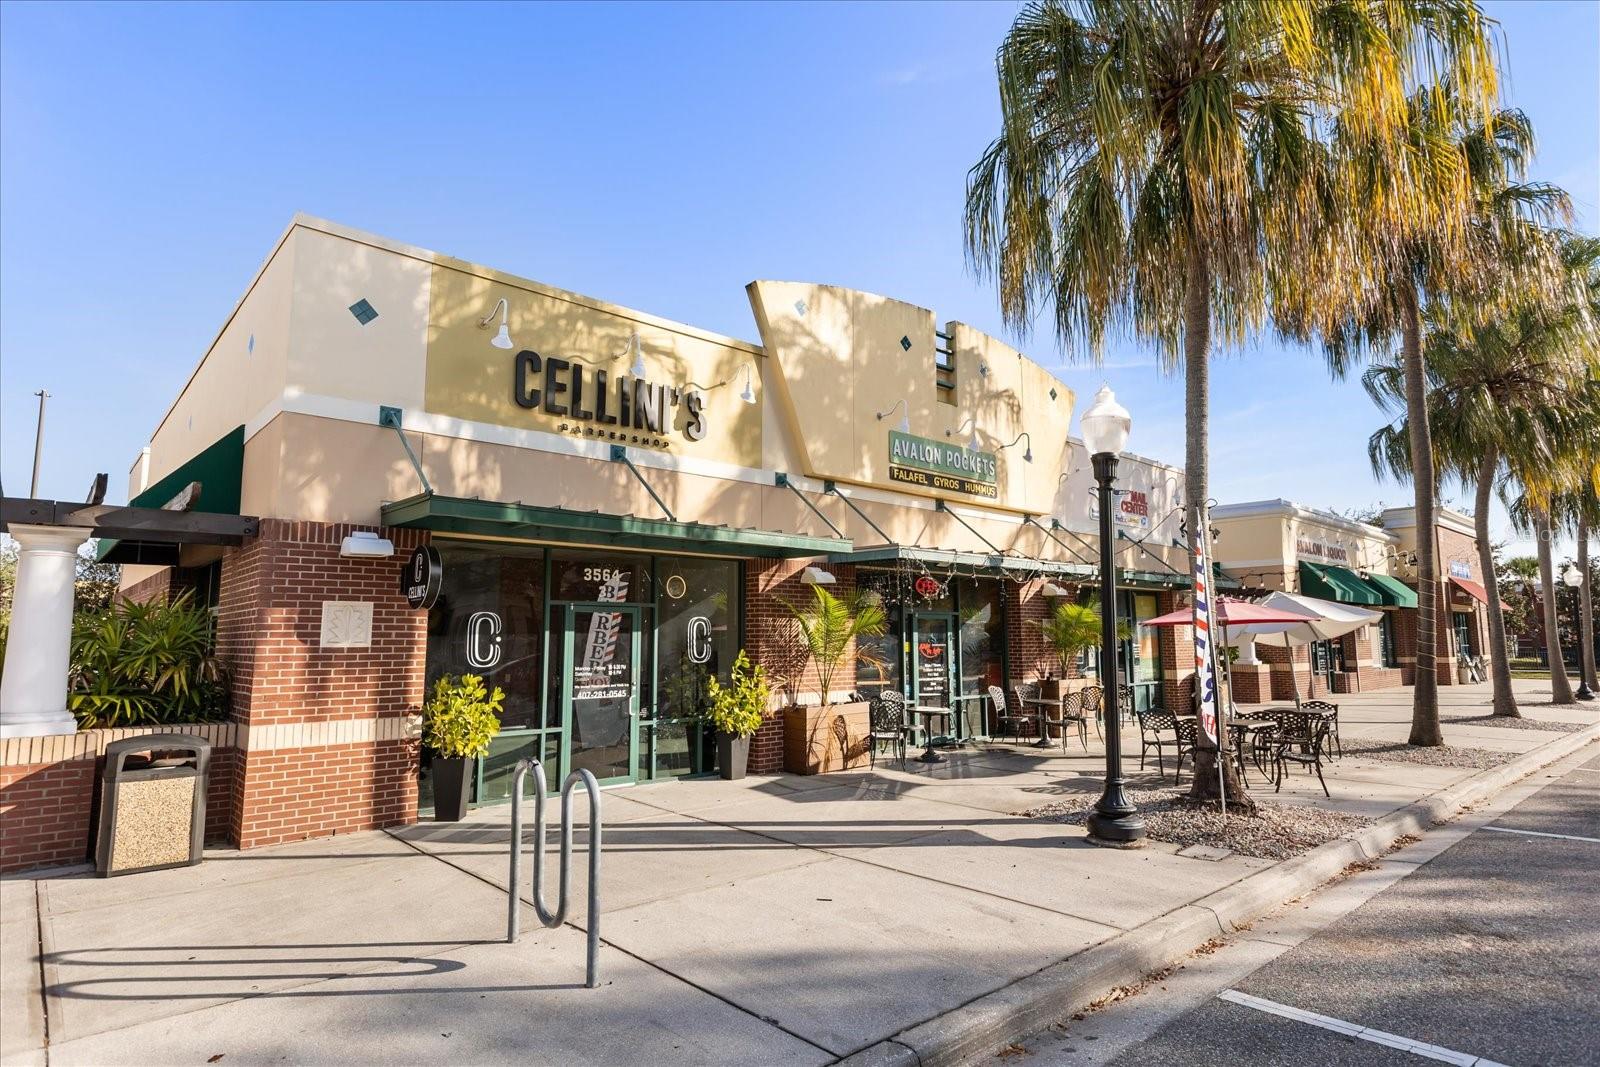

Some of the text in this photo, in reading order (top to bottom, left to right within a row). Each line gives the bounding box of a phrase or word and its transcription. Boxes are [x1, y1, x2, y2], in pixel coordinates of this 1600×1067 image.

[514, 350, 707, 442] CELLINI'S
[893, 438, 996, 477] AVALON POCKETS
[893, 468, 996, 497] FALAFEL GYROS HUMMUS
[1120, 500, 1148, 517] CENTER
[1130, 490, 1148, 505] MAIL
[583, 567, 620, 581] 3564
